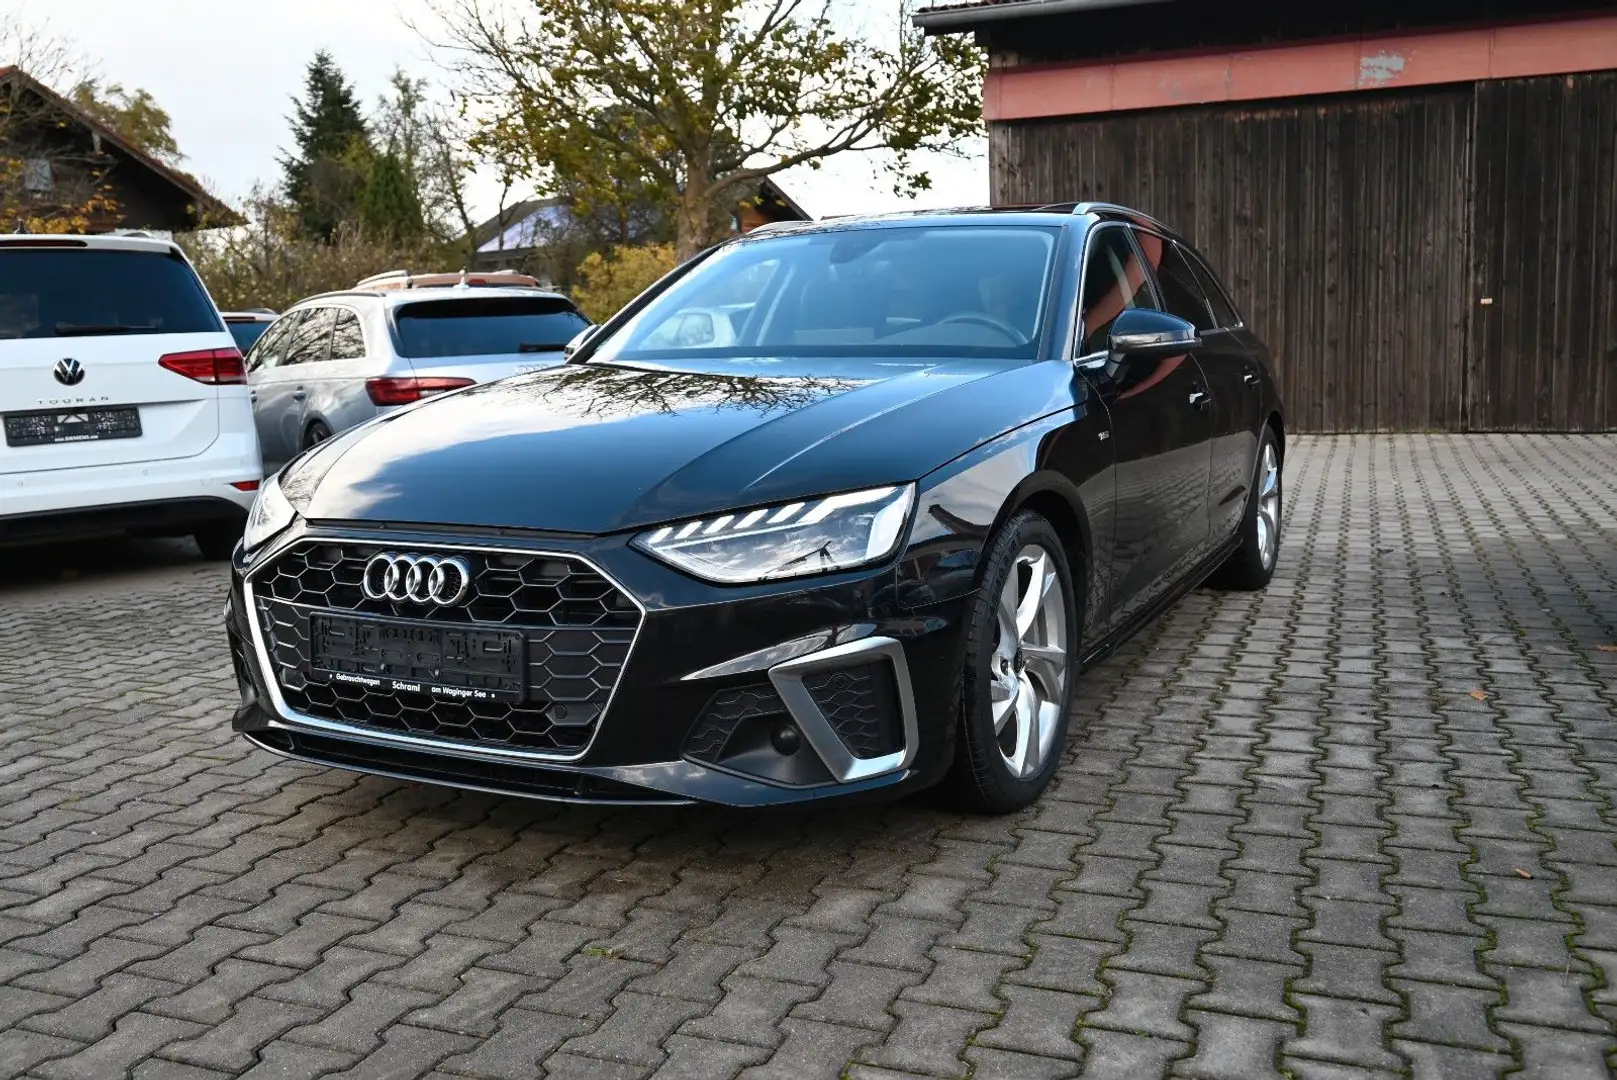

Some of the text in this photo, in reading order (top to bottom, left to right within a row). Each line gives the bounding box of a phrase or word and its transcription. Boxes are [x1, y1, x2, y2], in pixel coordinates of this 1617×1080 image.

[37, 396, 109, 405] TOURAN
[335, 673, 381, 686] Gebrauchtwagen
[392, 681, 421, 692] Schraml
[442, 686, 473, 697] Waginger
[473, 690, 487, 698] See
